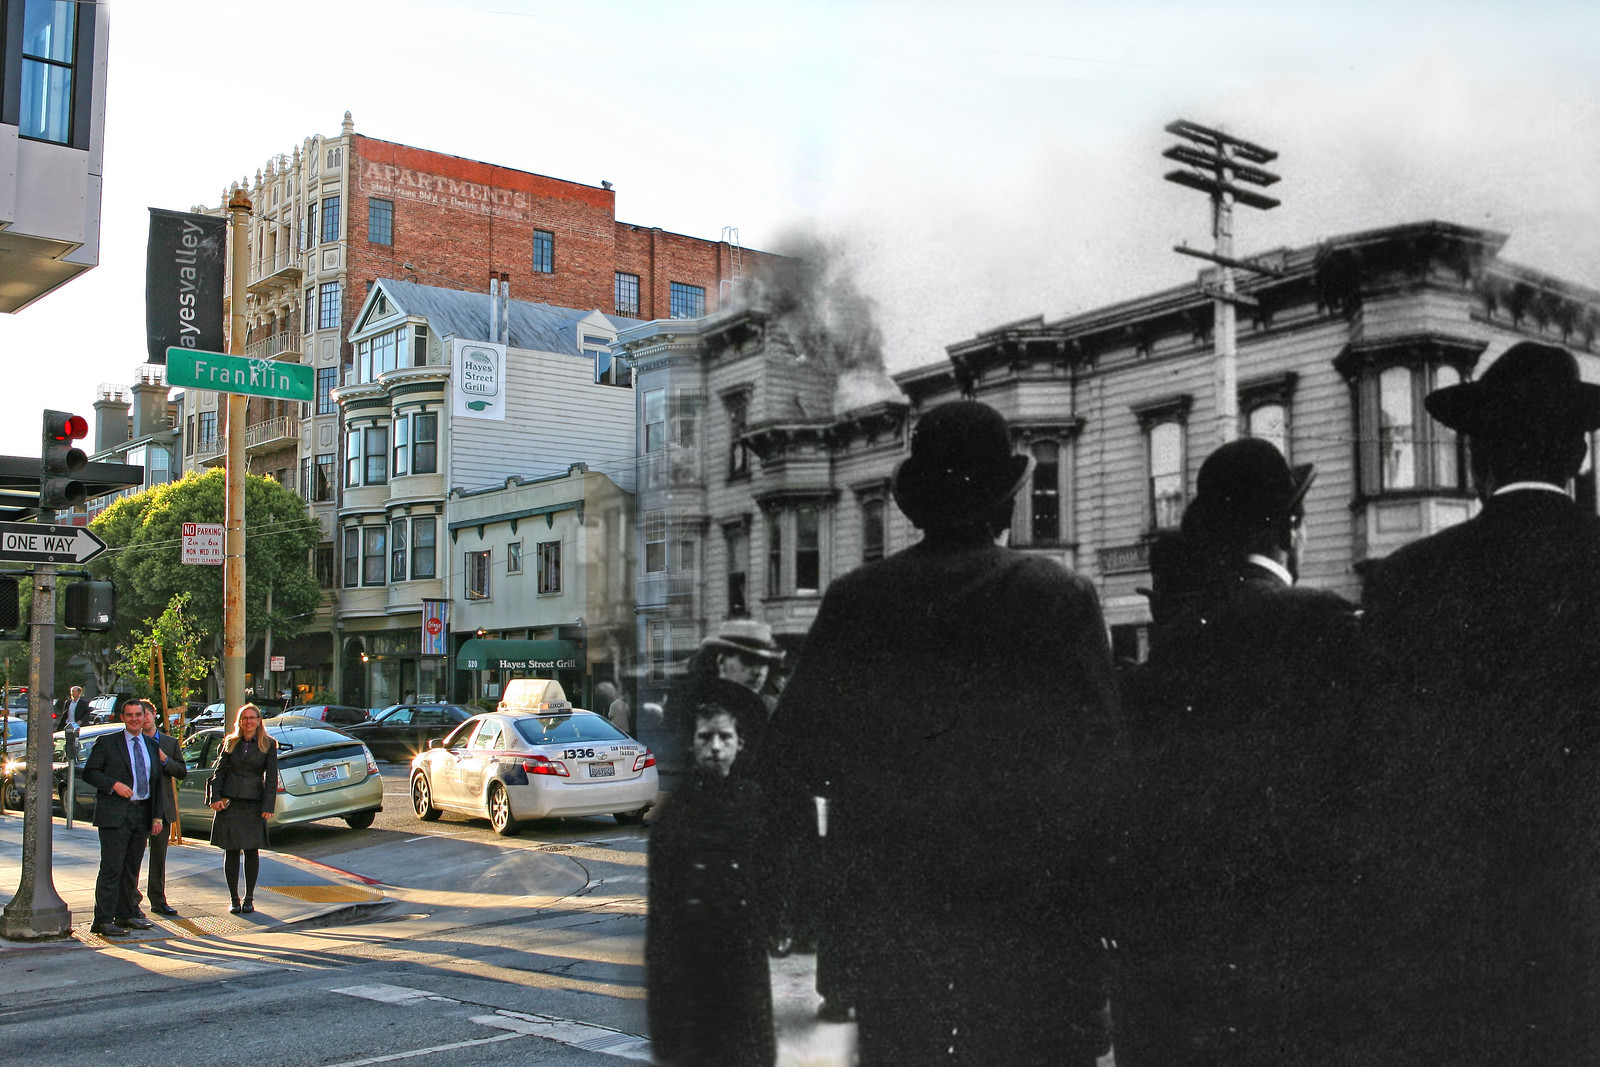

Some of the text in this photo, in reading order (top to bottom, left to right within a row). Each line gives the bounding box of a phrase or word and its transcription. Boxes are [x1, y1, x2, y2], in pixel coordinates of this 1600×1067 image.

[365, 162, 527, 208] APARTMENTS
[175, 219, 204, 348] ayesvalley
[465, 361, 492, 372] Hayes
[194, 360, 291, 391] Franklin
[465, 371, 493, 382] Street
[464, 382, 485, 391] Grill
[184, 524, 222, 536] NO PARKING
[7, 534, 75, 552] ONE WAY
[199, 548, 210, 556] WED
[211, 548, 220, 556] FRI
[499, 659, 526, 669] Hayes
[528, 660, 554, 668] Street
[556, 659, 576, 668] Grill
[563, 748, 595, 760] 1336
